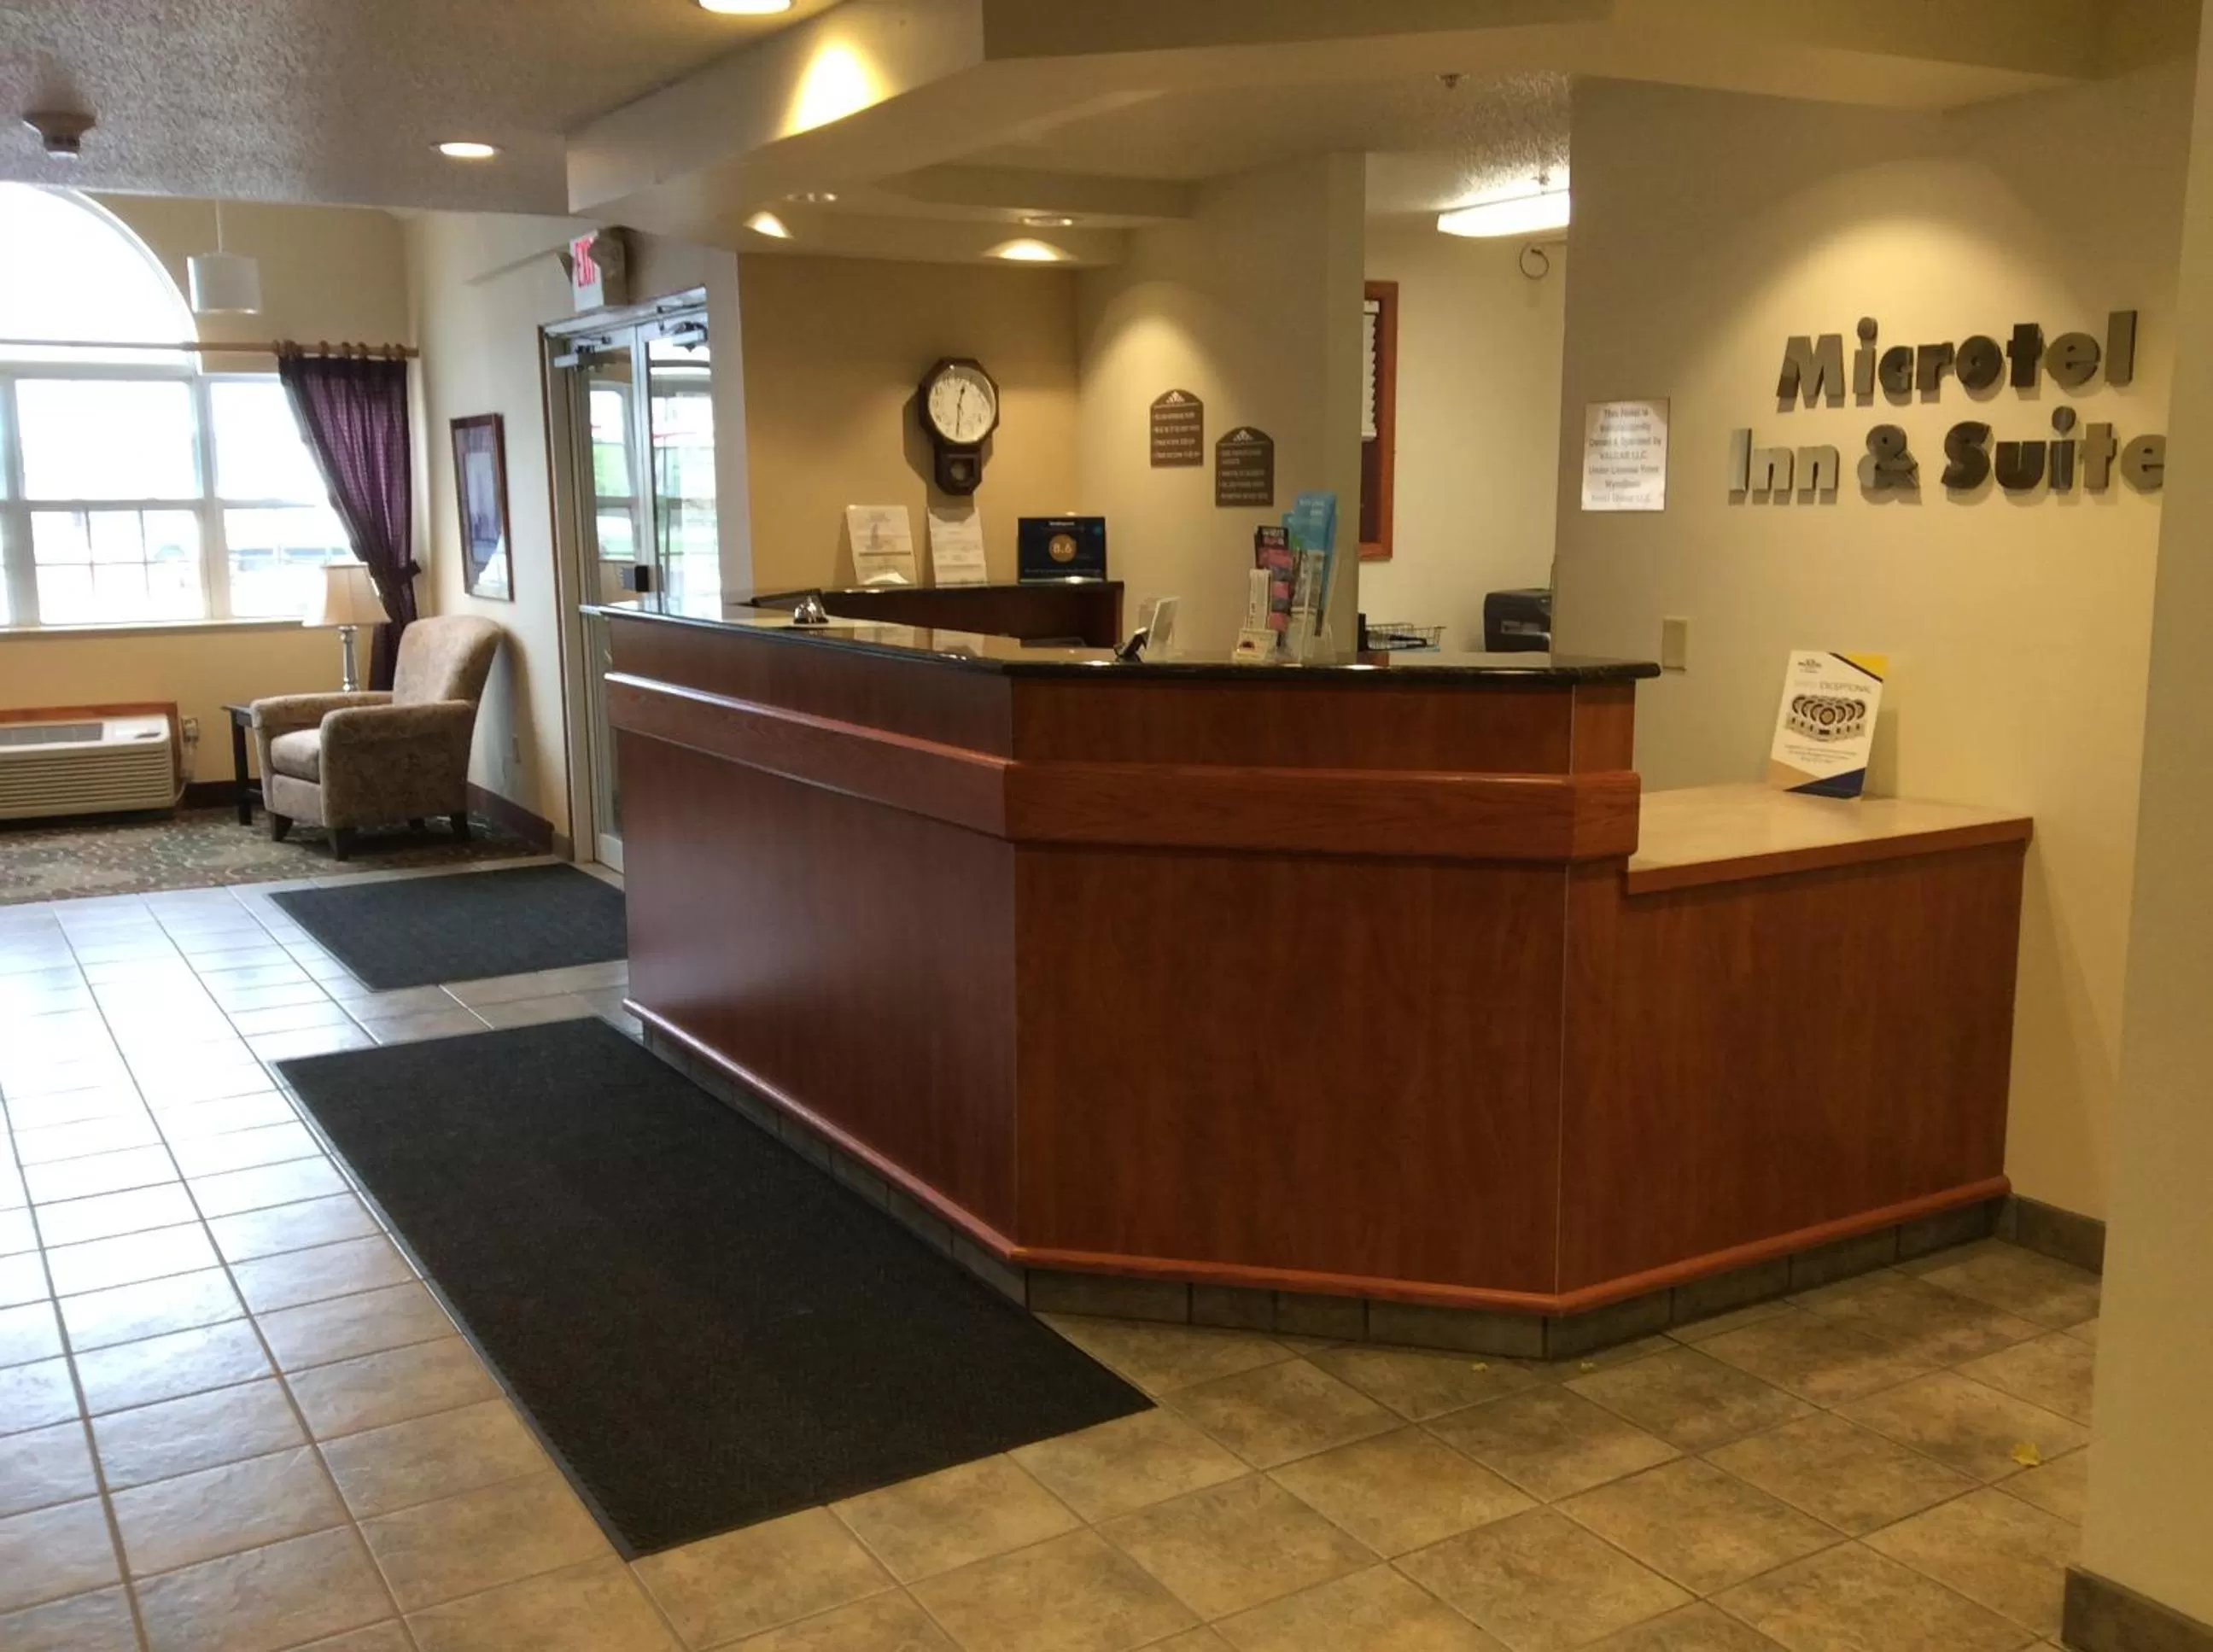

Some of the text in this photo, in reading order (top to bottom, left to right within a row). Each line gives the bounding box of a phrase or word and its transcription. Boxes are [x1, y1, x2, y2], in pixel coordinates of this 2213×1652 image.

[1776, 310, 2138, 400] Microtel
[1729, 428, 1840, 492] Inn
[1857, 423, 1920, 490] &
